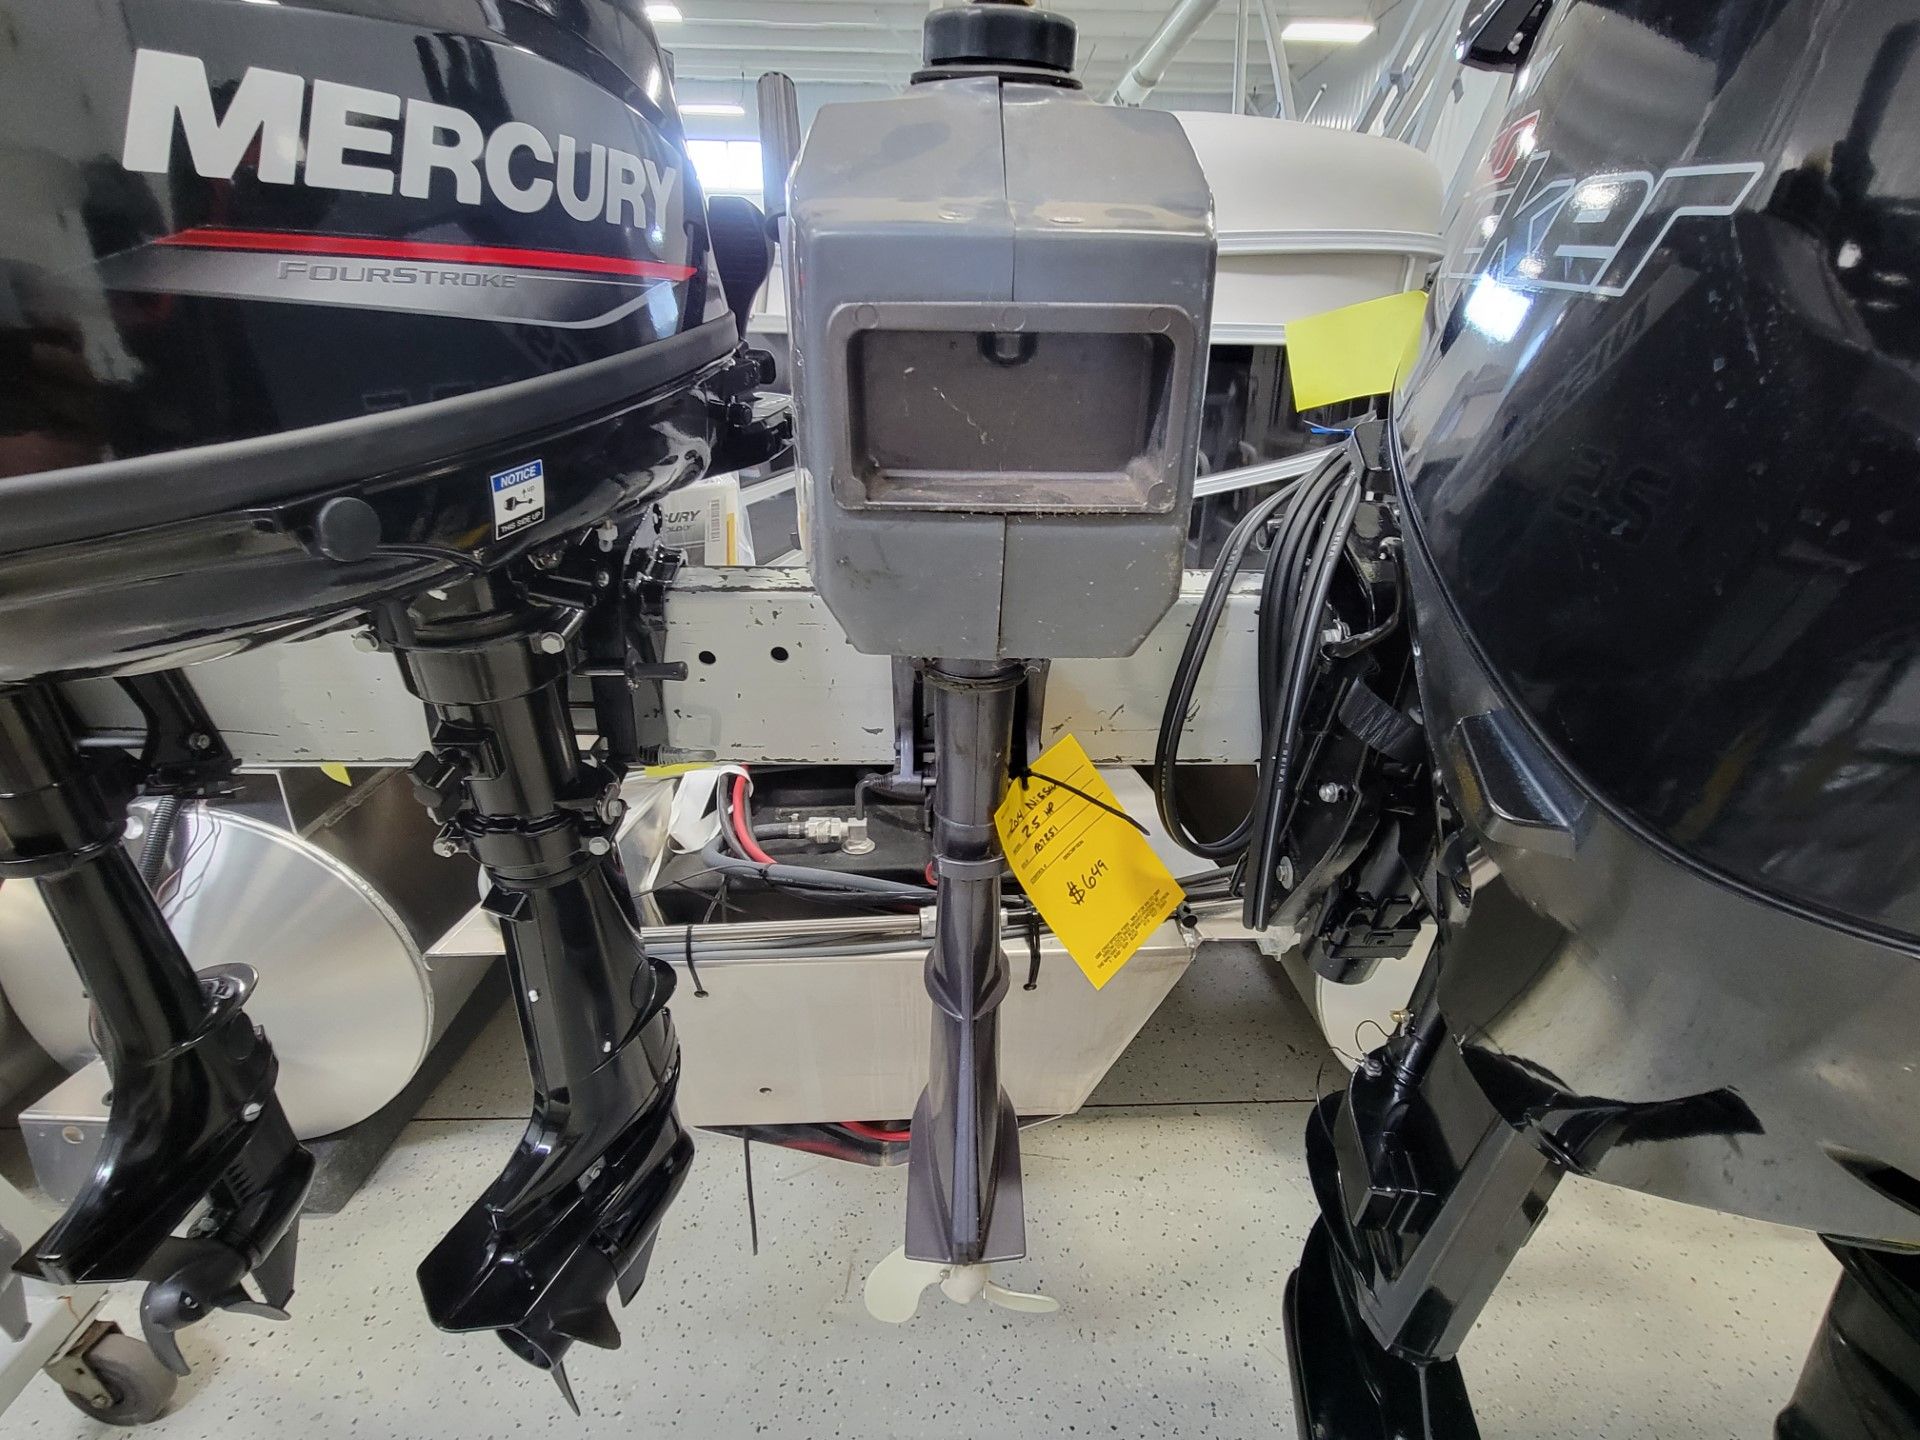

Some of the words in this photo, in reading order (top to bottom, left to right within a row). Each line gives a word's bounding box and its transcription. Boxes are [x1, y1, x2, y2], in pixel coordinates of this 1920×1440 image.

[122, 48, 677, 230] MERCURY
[500, 465, 537, 488] NOTICE
[501, 522, 516, 533] THIS
[516, 515, 532, 527] SIDE
[531, 510, 542, 520] UP
[665, 510, 701, 524] URY
[1021, 815, 1040, 839] 2.5
[1044, 801, 1054, 817] HP
[1066, 859, 1109, 905] $649
